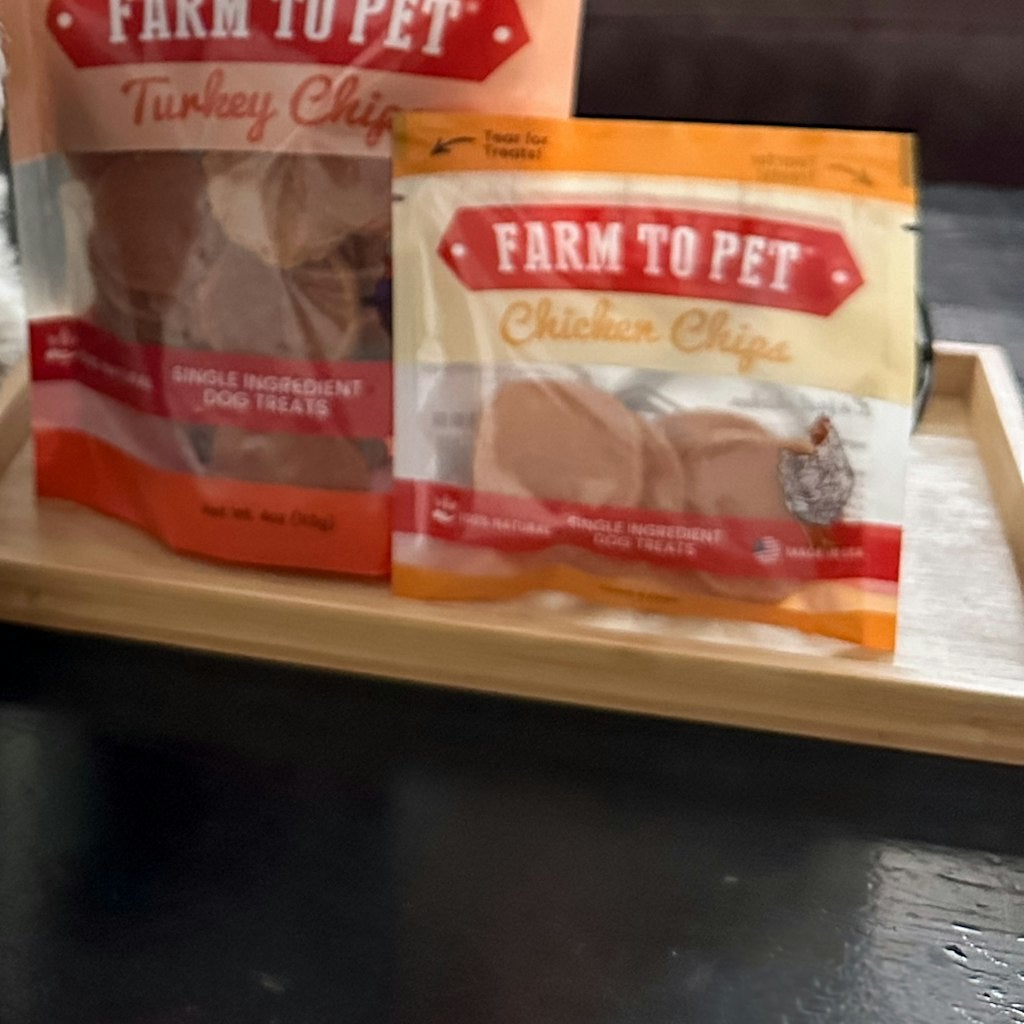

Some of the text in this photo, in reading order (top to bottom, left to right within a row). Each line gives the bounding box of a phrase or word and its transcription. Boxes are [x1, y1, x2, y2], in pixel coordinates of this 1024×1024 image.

[120, 69, 401, 148] Turkey Chip
[493, 221, 802, 292] FARM TO PET
[499, 297, 794, 374] Chicken Chips
[171, 365, 239, 388] SINGLE
[243, 373, 363, 397] INGREDIENT
[203, 388, 329, 420] DOG TREATS
[567, 516, 723, 543] SINGLE INGREDIENT
[593, 532, 696, 557] DOG TREATS
